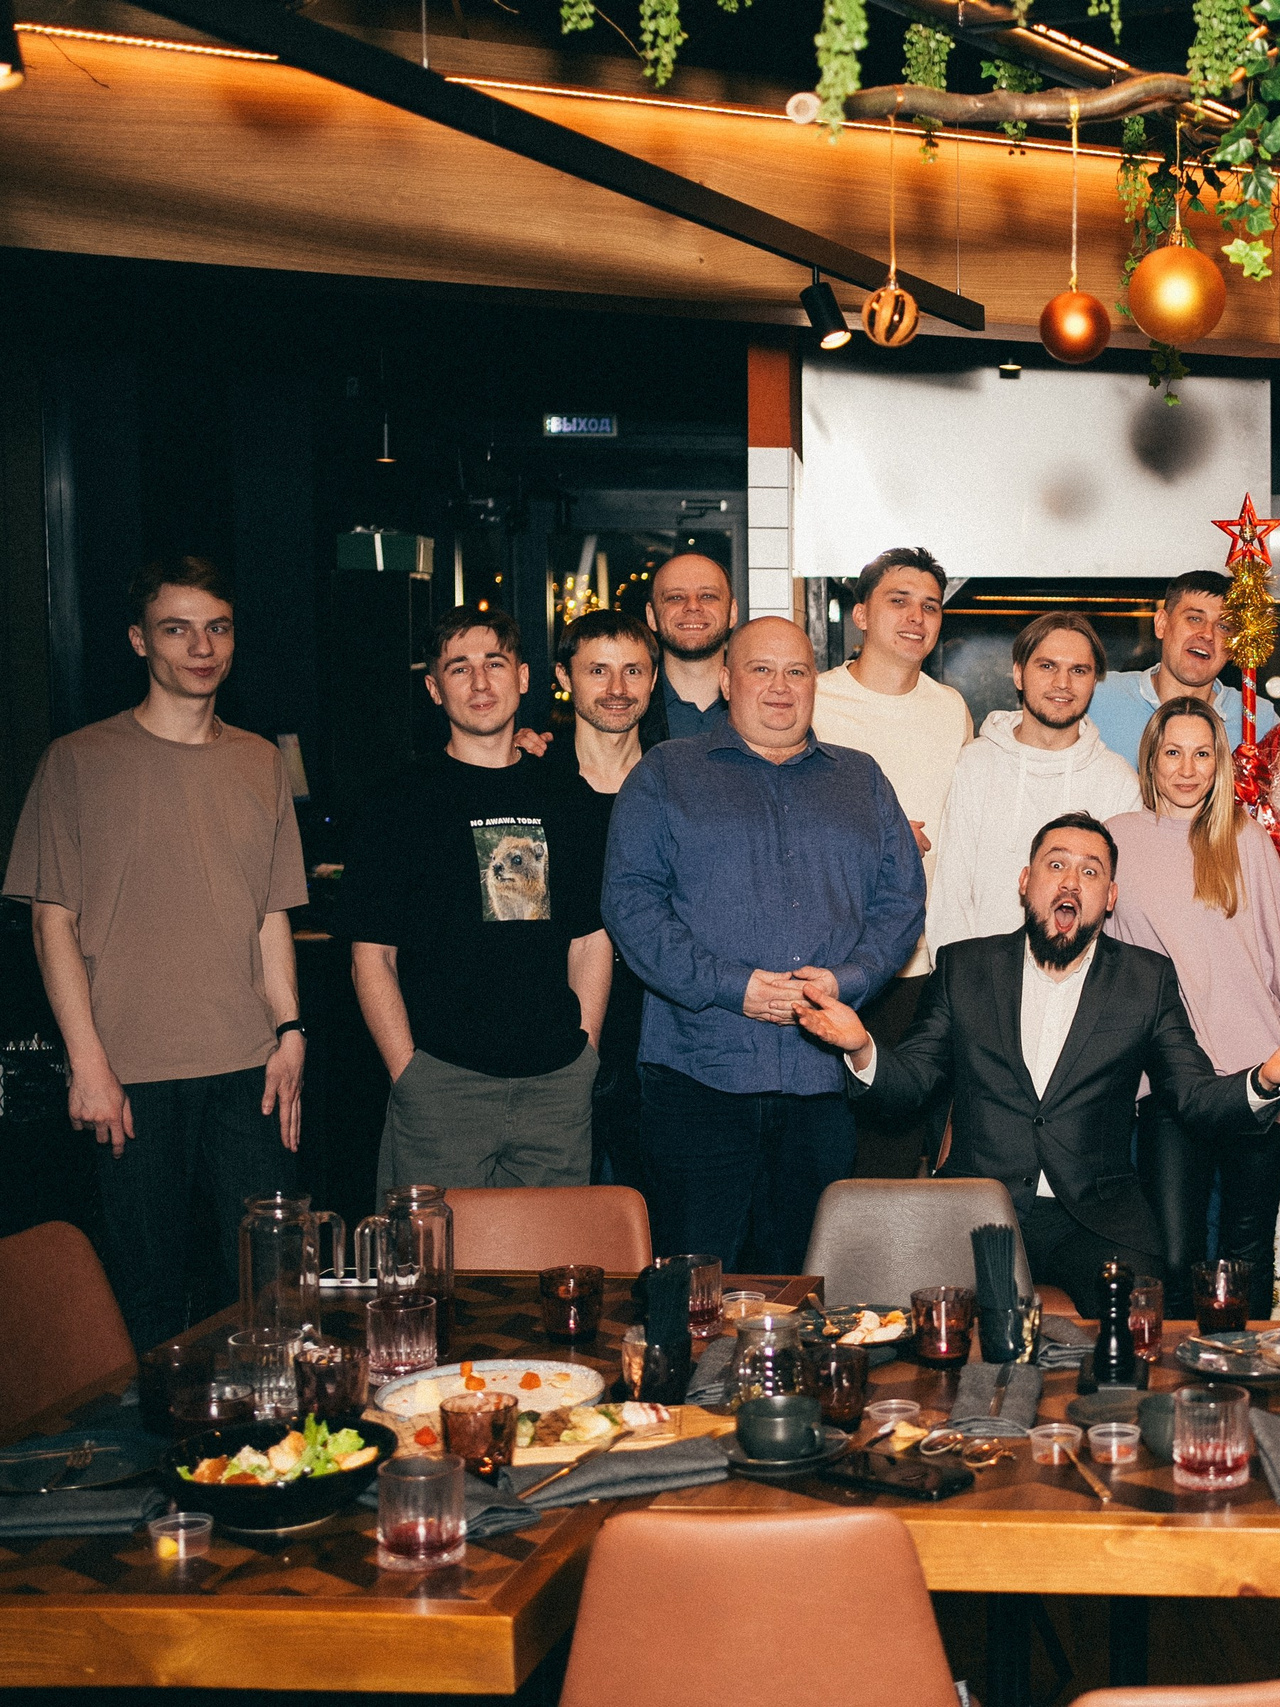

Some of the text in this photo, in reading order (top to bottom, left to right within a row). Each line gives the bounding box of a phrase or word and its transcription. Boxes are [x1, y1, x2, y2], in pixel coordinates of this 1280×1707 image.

[550, 416, 611, 433] ВЫХОД
[485, 817, 516, 826] AWAWA
[516, 817, 542, 825] TODAY
